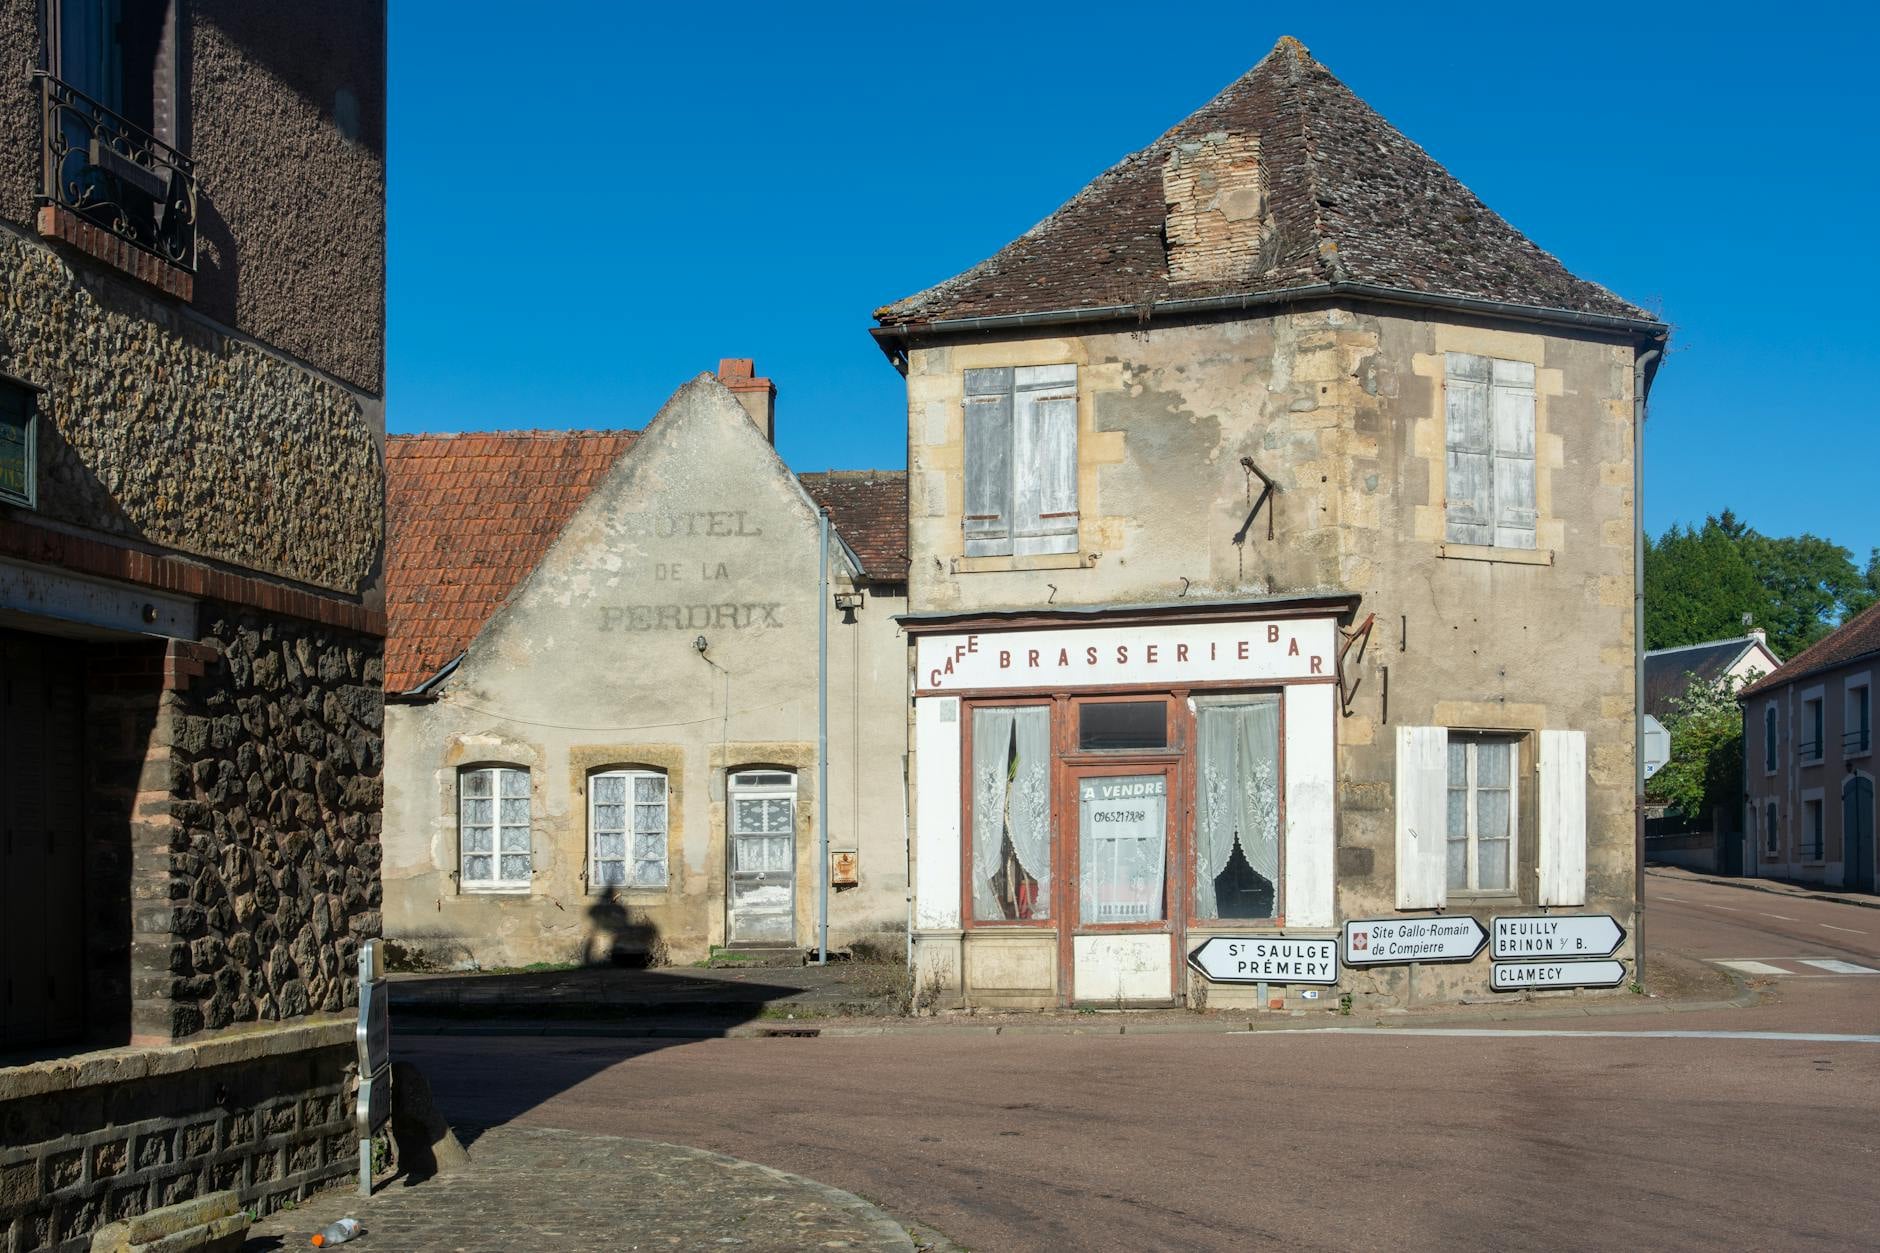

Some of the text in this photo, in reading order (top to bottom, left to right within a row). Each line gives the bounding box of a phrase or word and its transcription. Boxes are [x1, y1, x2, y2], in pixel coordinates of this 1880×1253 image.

[655, 561, 729, 581] DE LA
[598, 602, 784, 632] PERDRIX
[930, 624, 1322, 688] CAFE BRASSERIE BAR
[1085, 782, 1163, 799] A VENDRE
[1372, 923, 1469, 939] Site Gallo-Romain
[1500, 922, 1558, 935] NEUILLY
[1257, 945, 1330, 959] SAULGE
[1372, 941, 1444, 957] de Compierre
[1500, 938, 1553, 951] BRINON
[1576, 938, 1587, 949] B.
[1238, 958, 1328, 976] PRÉMERY
[1500, 967, 1563, 981] CLAMECY
